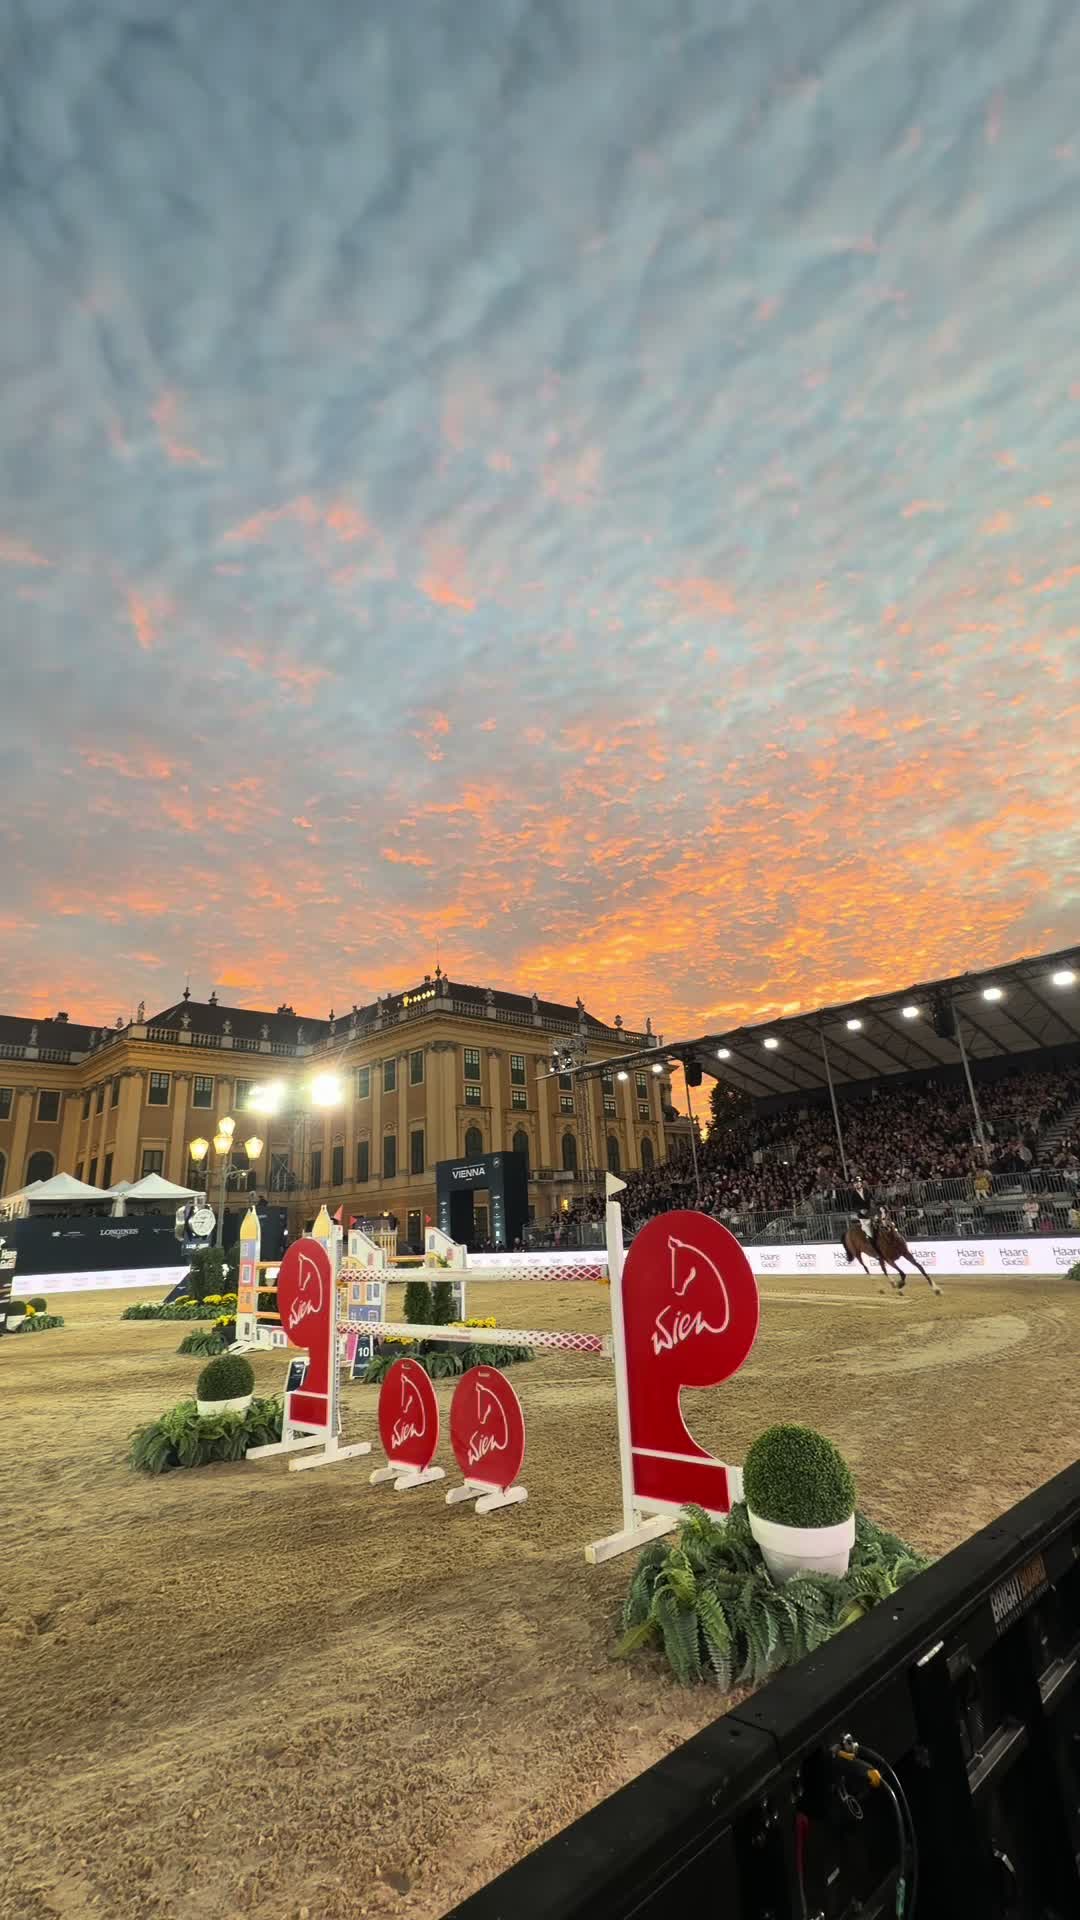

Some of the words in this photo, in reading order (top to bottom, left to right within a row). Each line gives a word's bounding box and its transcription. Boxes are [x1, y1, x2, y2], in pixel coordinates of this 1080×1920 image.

[452, 1167, 485, 1179] VIENNA
[957, 1248, 985, 1257] Haare
[1000, 1248, 1029, 1257] Haare
[358, 1346, 370, 1357] 10
